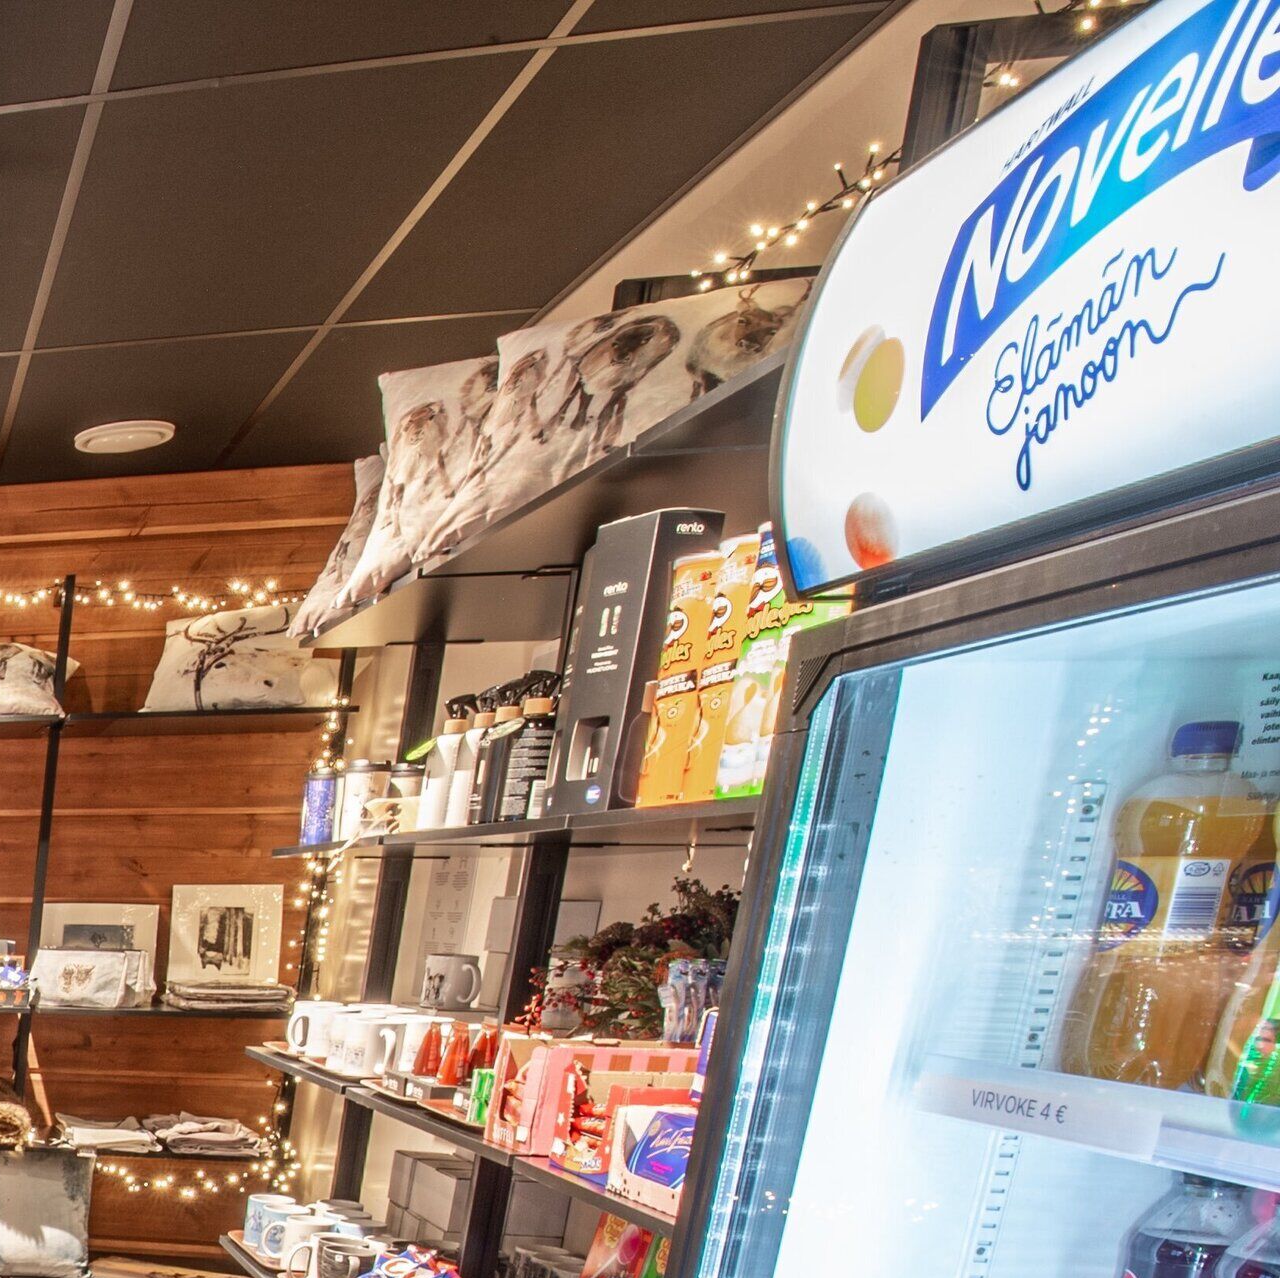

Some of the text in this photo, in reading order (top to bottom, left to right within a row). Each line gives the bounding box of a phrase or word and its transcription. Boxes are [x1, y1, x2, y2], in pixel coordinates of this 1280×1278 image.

[1016, 251, 1226, 491] janoon
[676, 521, 705, 534] rento
[604, 581, 629, 596] rento
[972, 1089, 1068, 1124] VIRVOKE 4 €
